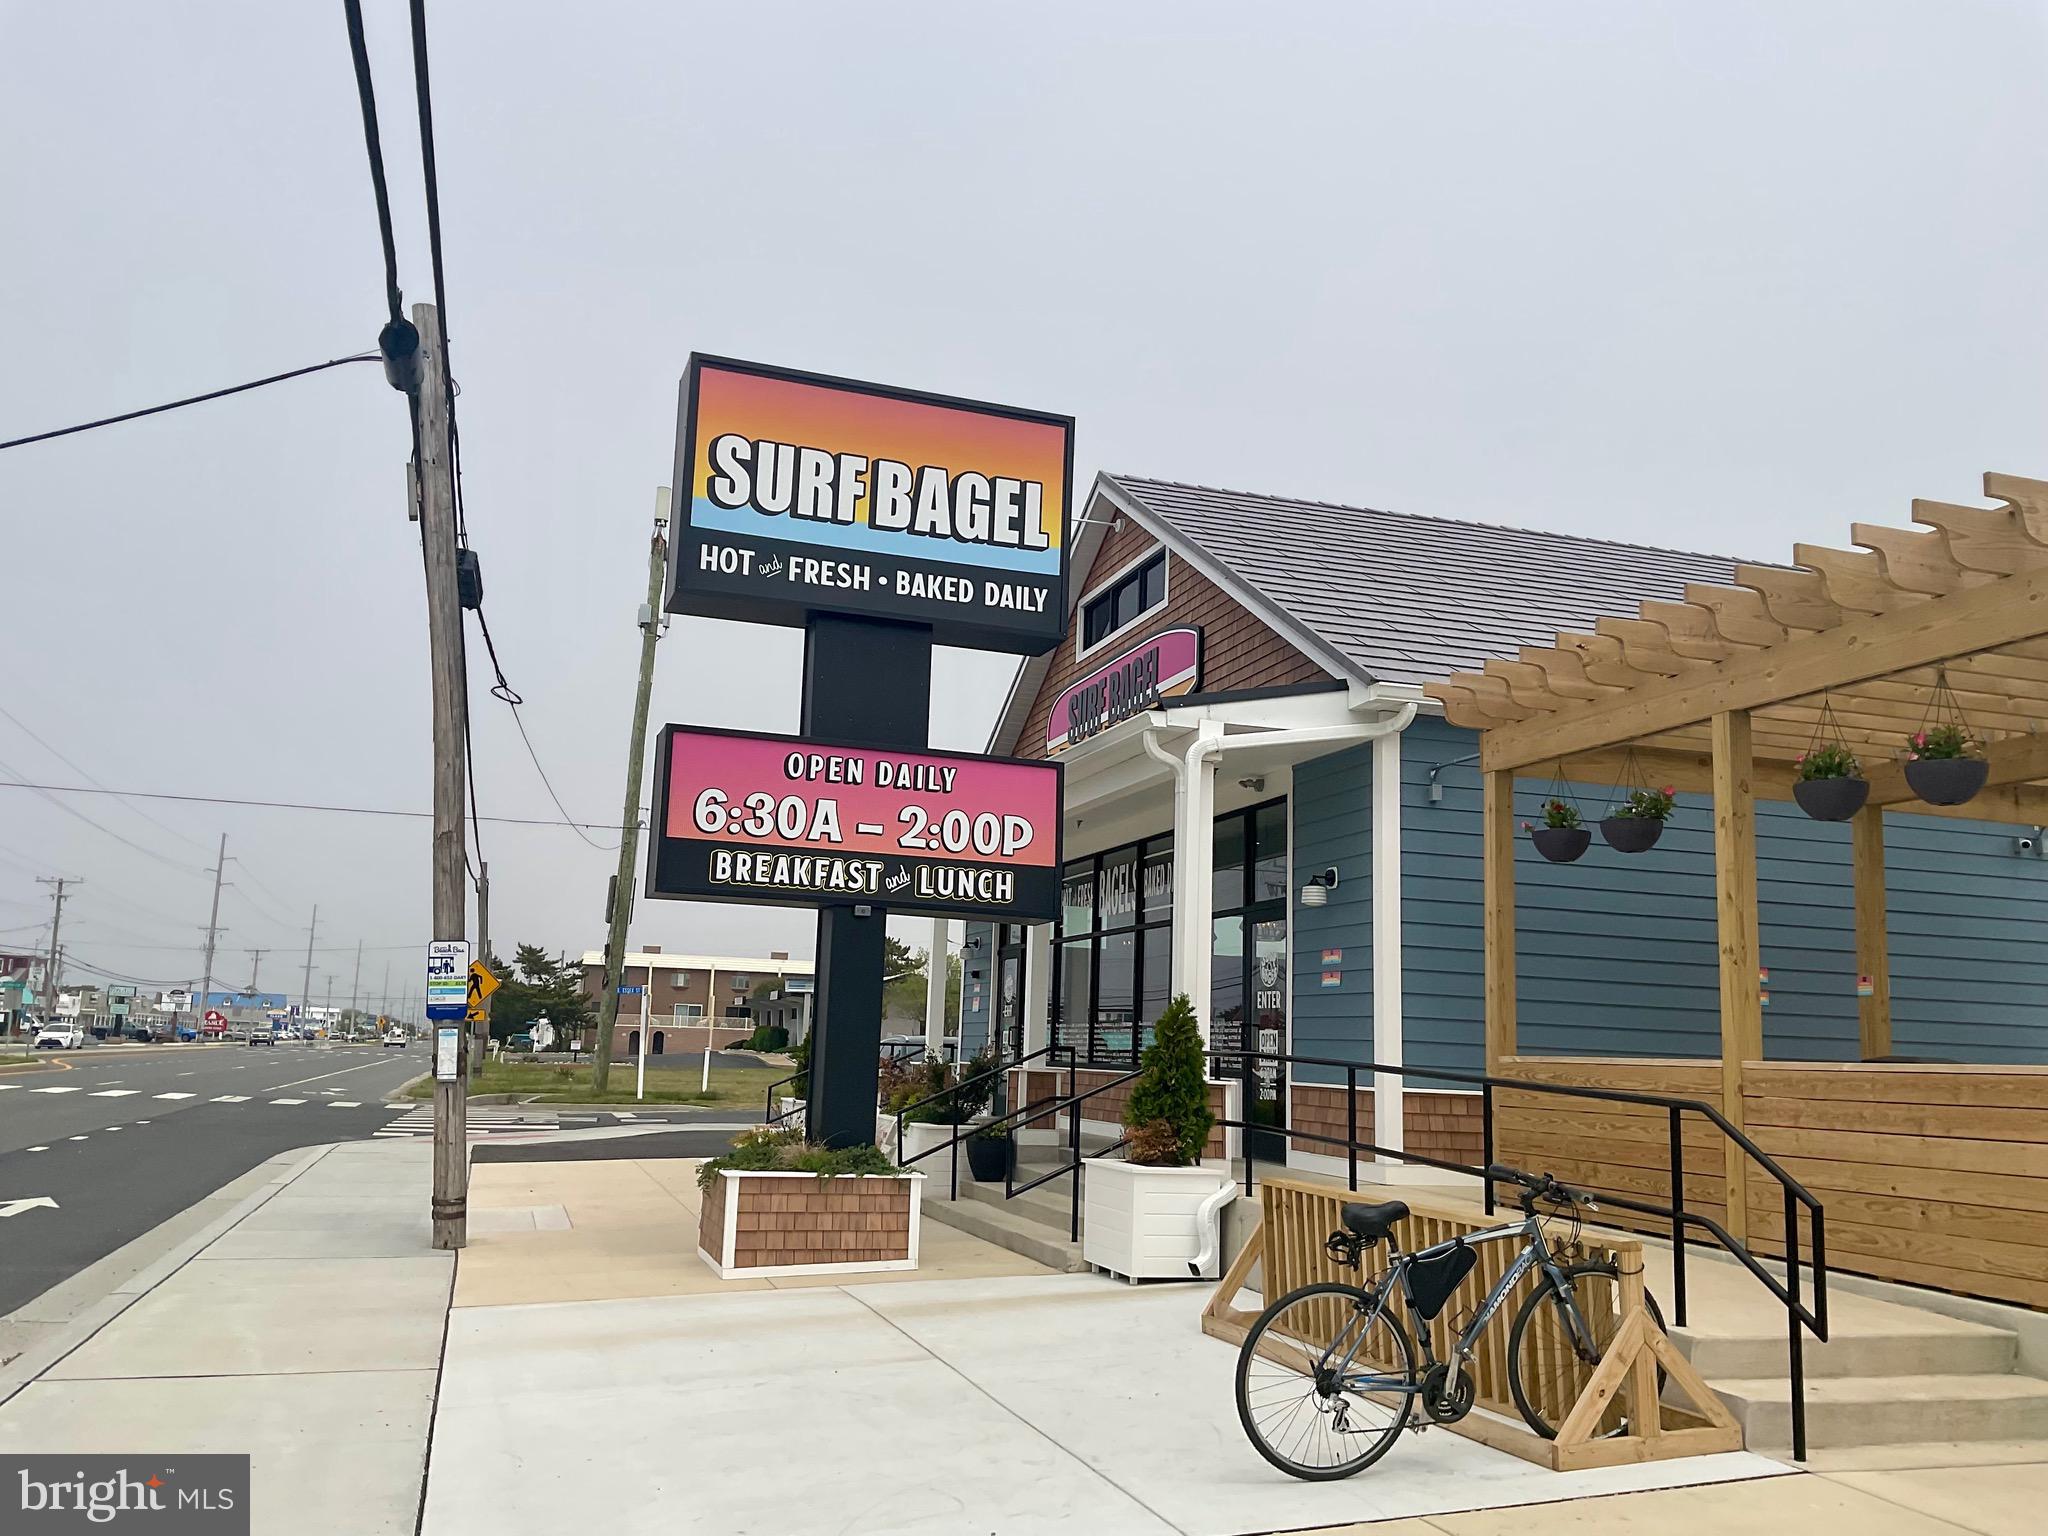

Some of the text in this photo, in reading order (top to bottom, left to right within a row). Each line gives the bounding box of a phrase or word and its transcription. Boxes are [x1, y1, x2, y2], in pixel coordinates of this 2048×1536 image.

[707, 433, 1050, 552] SURF BAGEL
[700, 543, 1048, 612] HOT and FRESH BAKED DAILY
[1067, 646, 1161, 745] SURF BAGEL
[784, 753, 957, 793] OPEN DAILY
[693, 788, 844, 844] 6:30A
[897, 804, 1034, 857] 2:00P
[709, 849, 1014, 904] BREAKFAST and LUNCH
[1257, 991, 1281, 1009] ENTER
[1261, 1033, 1277, 1048] OPEN
